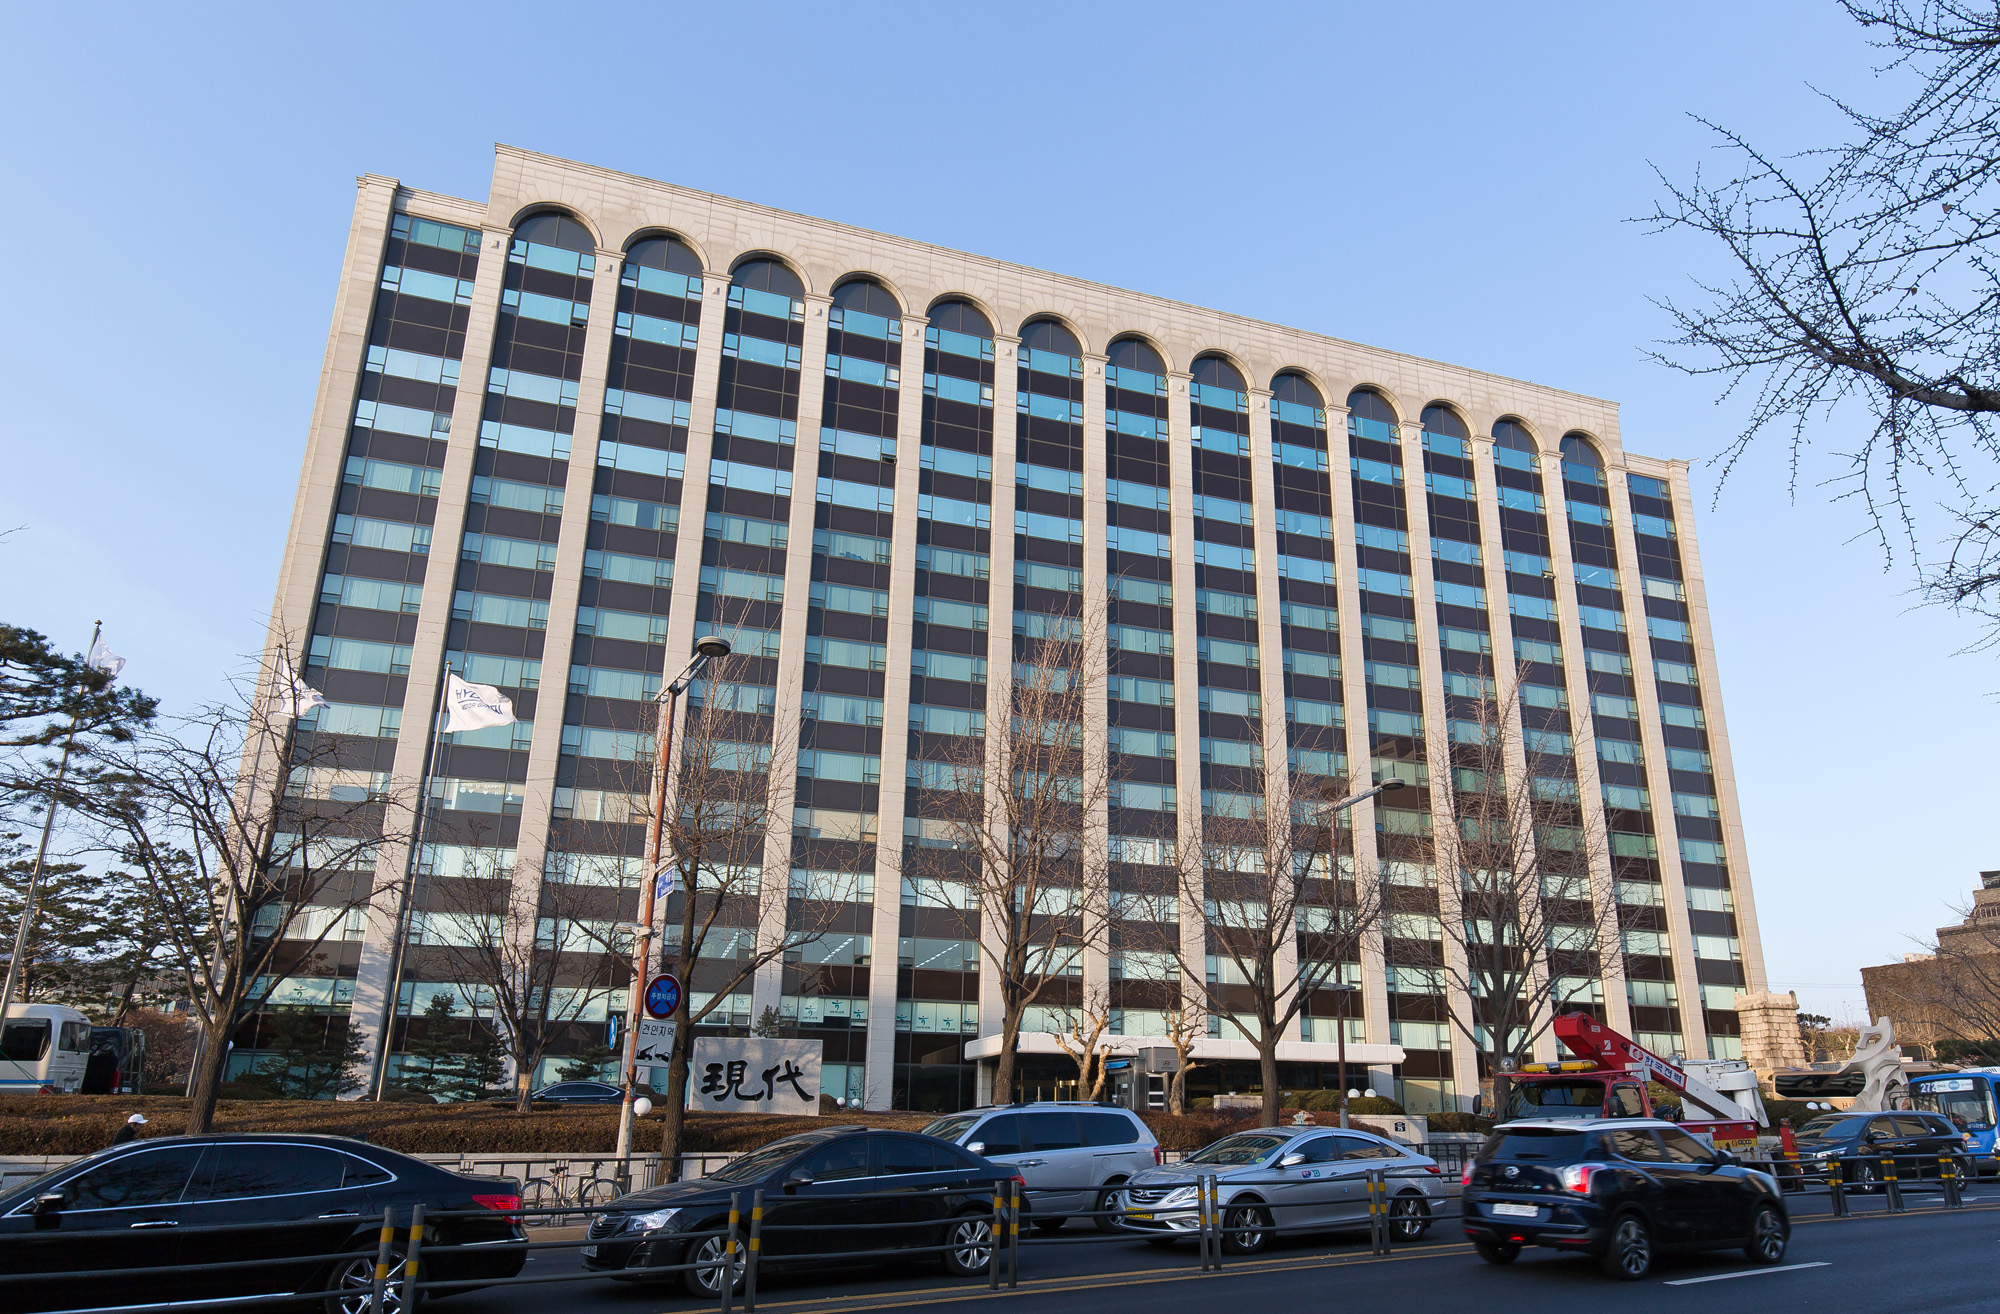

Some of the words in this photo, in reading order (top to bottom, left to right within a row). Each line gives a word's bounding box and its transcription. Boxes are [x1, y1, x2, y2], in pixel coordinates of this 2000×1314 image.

[651, 992, 677, 1001] 주정차금지
[642, 1024, 674, 1037] 견인지역
[1645, 1055, 1682, 1084] 한국전력
[701, 1060, 815, 1102] 現代
[1920, 1082, 1936, 1092] 272
